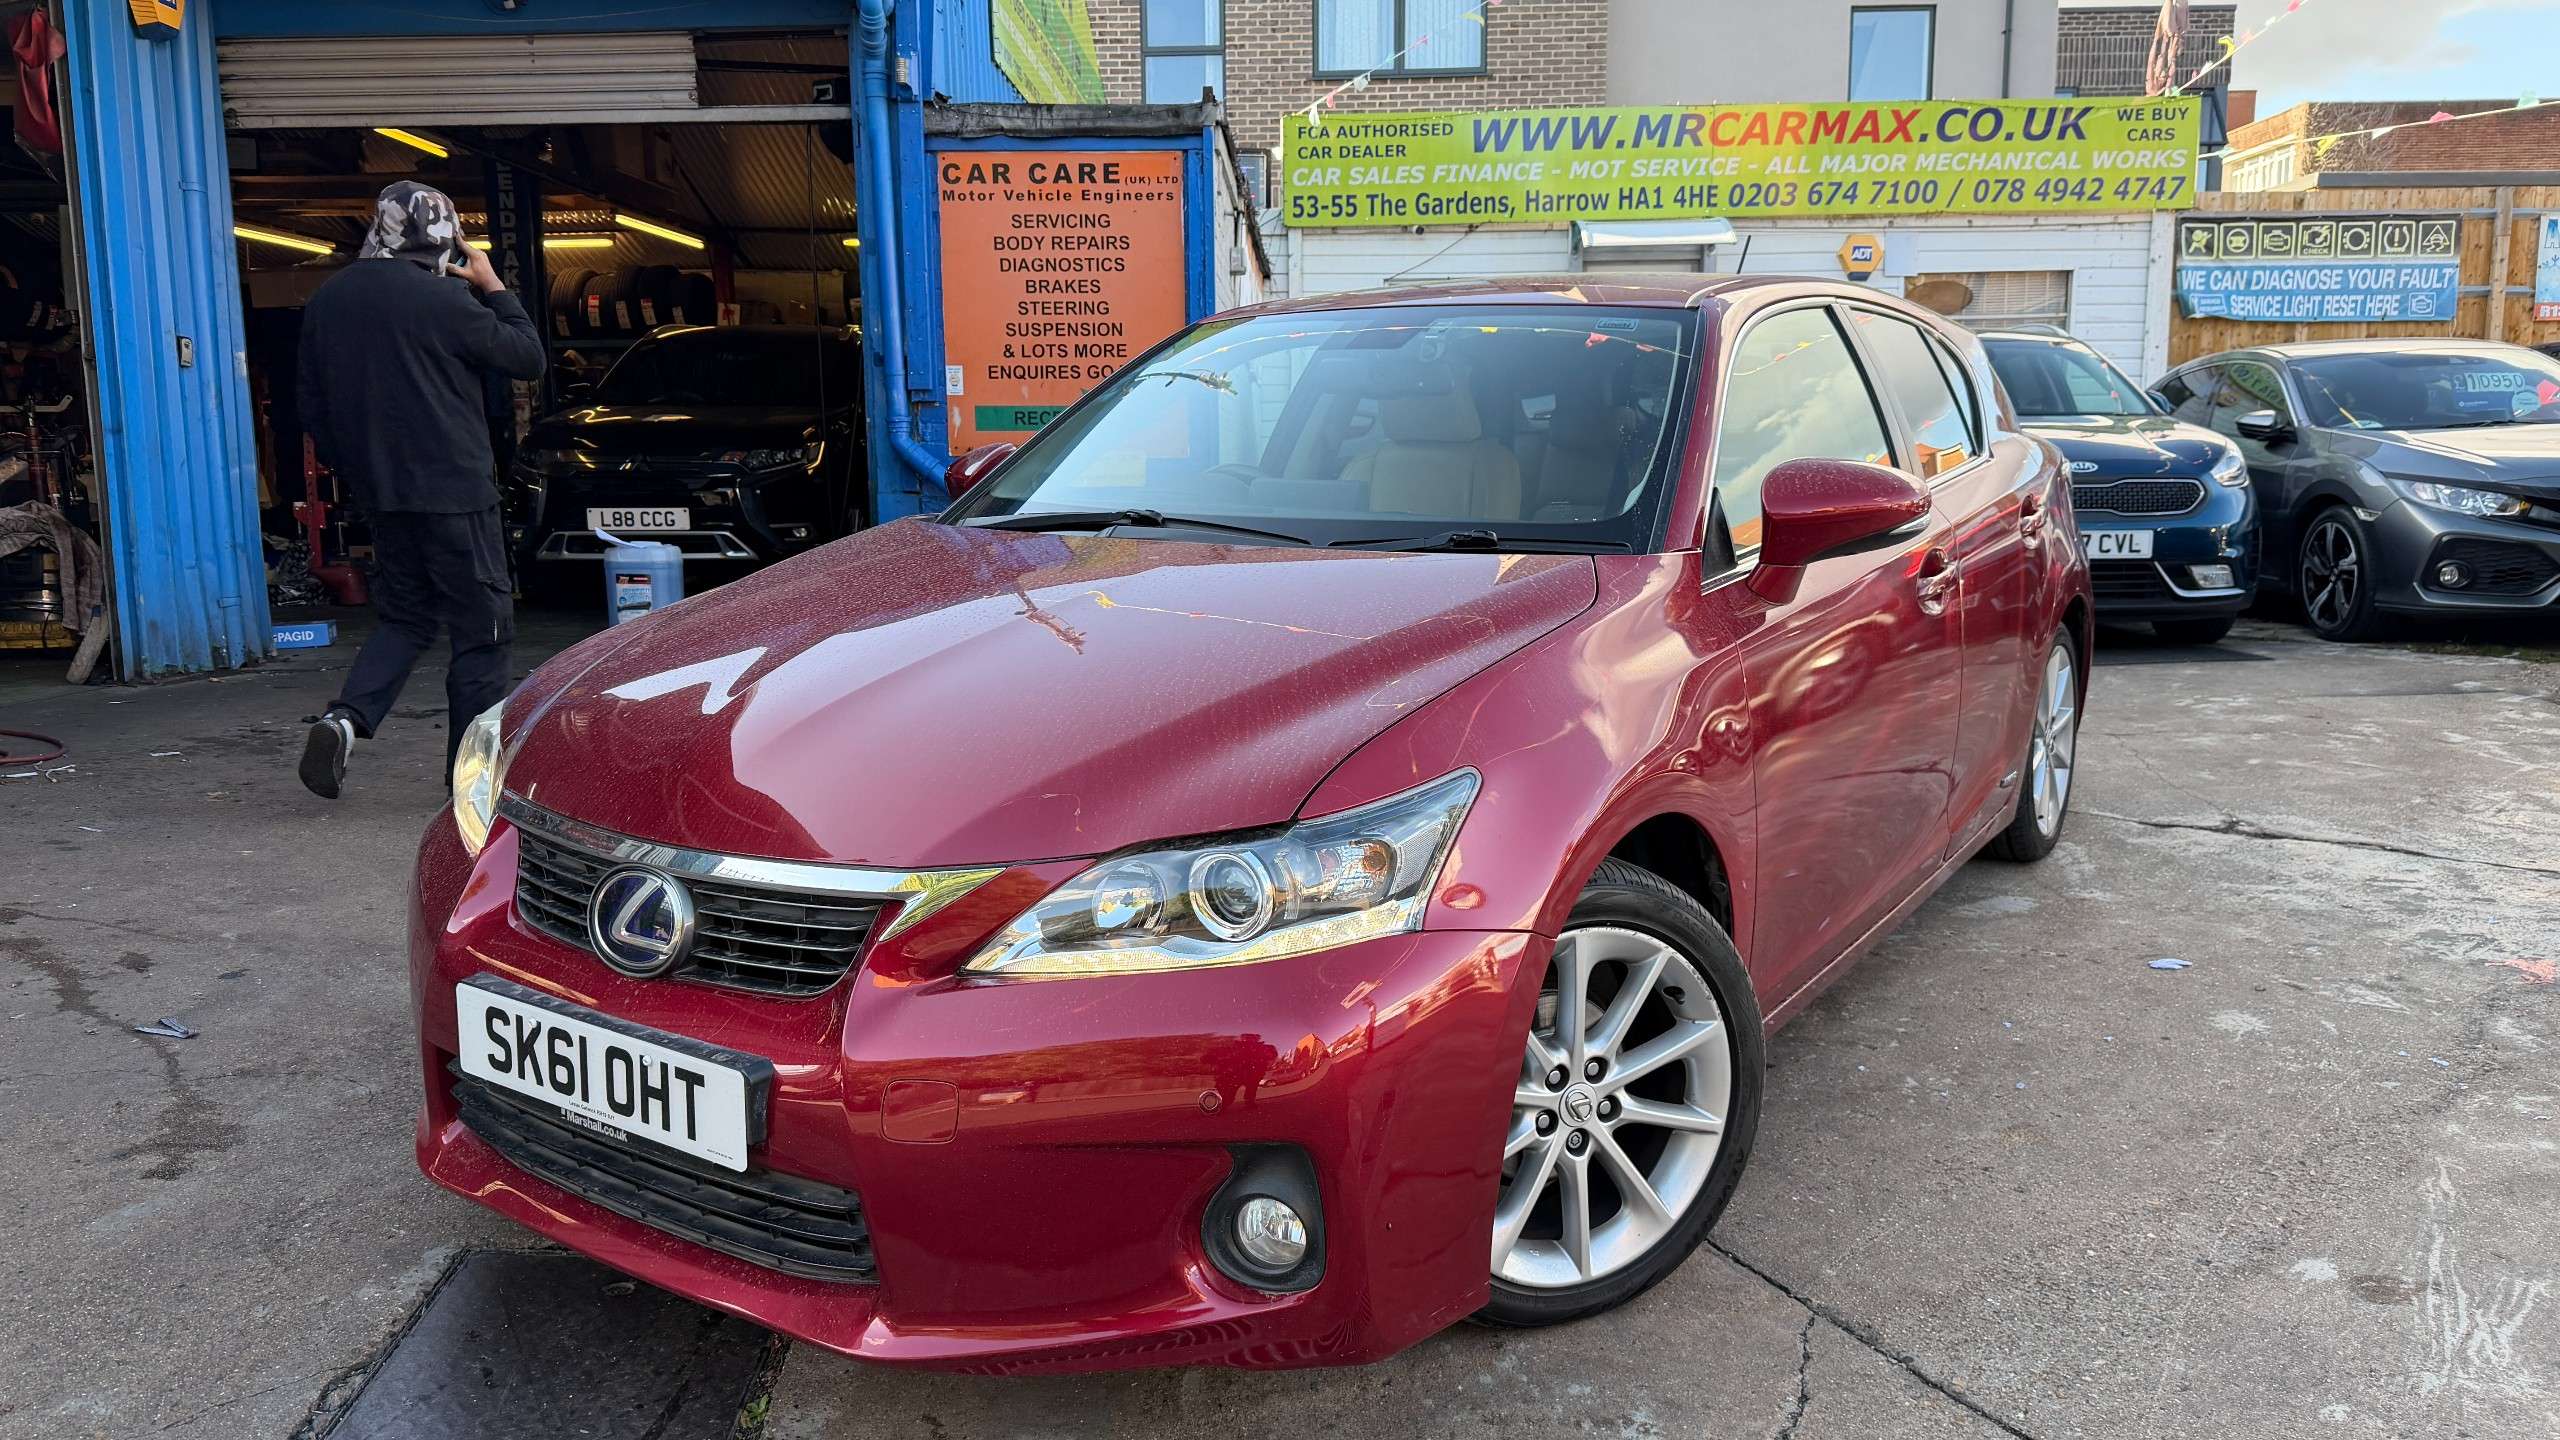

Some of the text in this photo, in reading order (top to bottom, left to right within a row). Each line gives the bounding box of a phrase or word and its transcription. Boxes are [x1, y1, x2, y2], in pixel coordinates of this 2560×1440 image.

[2116, 106, 2189, 122] WE BUY
[1298, 122, 1454, 139] FCA AUTHORISED
[1472, 106, 2096, 154] WWW.MRCARMAX.CO.UK
[2127, 127, 2176, 142] CARS
[1297, 144, 1407, 160] CAR DEALER
[942, 162, 1179, 186] CAR CARE (UK) LTD
[1292, 167, 1341, 187] CAR
[1348, 165, 1425, 185] SALES
[1431, 162, 1544, 183] FINANCE
[1568, 159, 1625, 180] MOT
[1631, 156, 1739, 179] SERVICE
[1765, 154, 1811, 174] ALL
[1820, 153, 1905, 174] MAJOR
[1915, 151, 2081, 173] MECHANICAL
[2091, 148, 2188, 169] WORKS
[942, 189, 1175, 204] Motor Vehicle Engineers
[1292, 176, 2186, 219] 53-55 The Gardens, Harrow HA1 4HE 0203 674 7100 / 078 4942 4747
[1011, 213, 1112, 229] SERVICING
[993, 235, 1131, 251] BODY REPAIRS
[1851, 247, 1872, 260] ADT
[999, 257, 1126, 273] DIAGNOSTICS
[1025, 279, 1101, 294] BRAKES
[2181, 267, 2454, 291] WE CAN DIAGNOSE YOUR FAULT
[1018, 300, 1111, 316] STEERING
[2230, 295, 2282, 317] SERVICE
[2283, 295, 2320, 317] LIGHT
[2322, 295, 2362, 317] RESET
[2365, 294, 2401, 316] HERE
[1005, 322, 1124, 337] SUSPENSION
[1003, 343, 1127, 358] & LOTS MORE
[988, 364, 1114, 380] ENQUIRES GO
[600, 511, 676, 527] L88 CCG
[2098, 533, 2142, 553] CVL
[277, 630, 314, 643] PAGID
[484, 1005, 706, 1142] SK61 OHT
[566, 1109, 629, 1142] Marshall.co.uk
